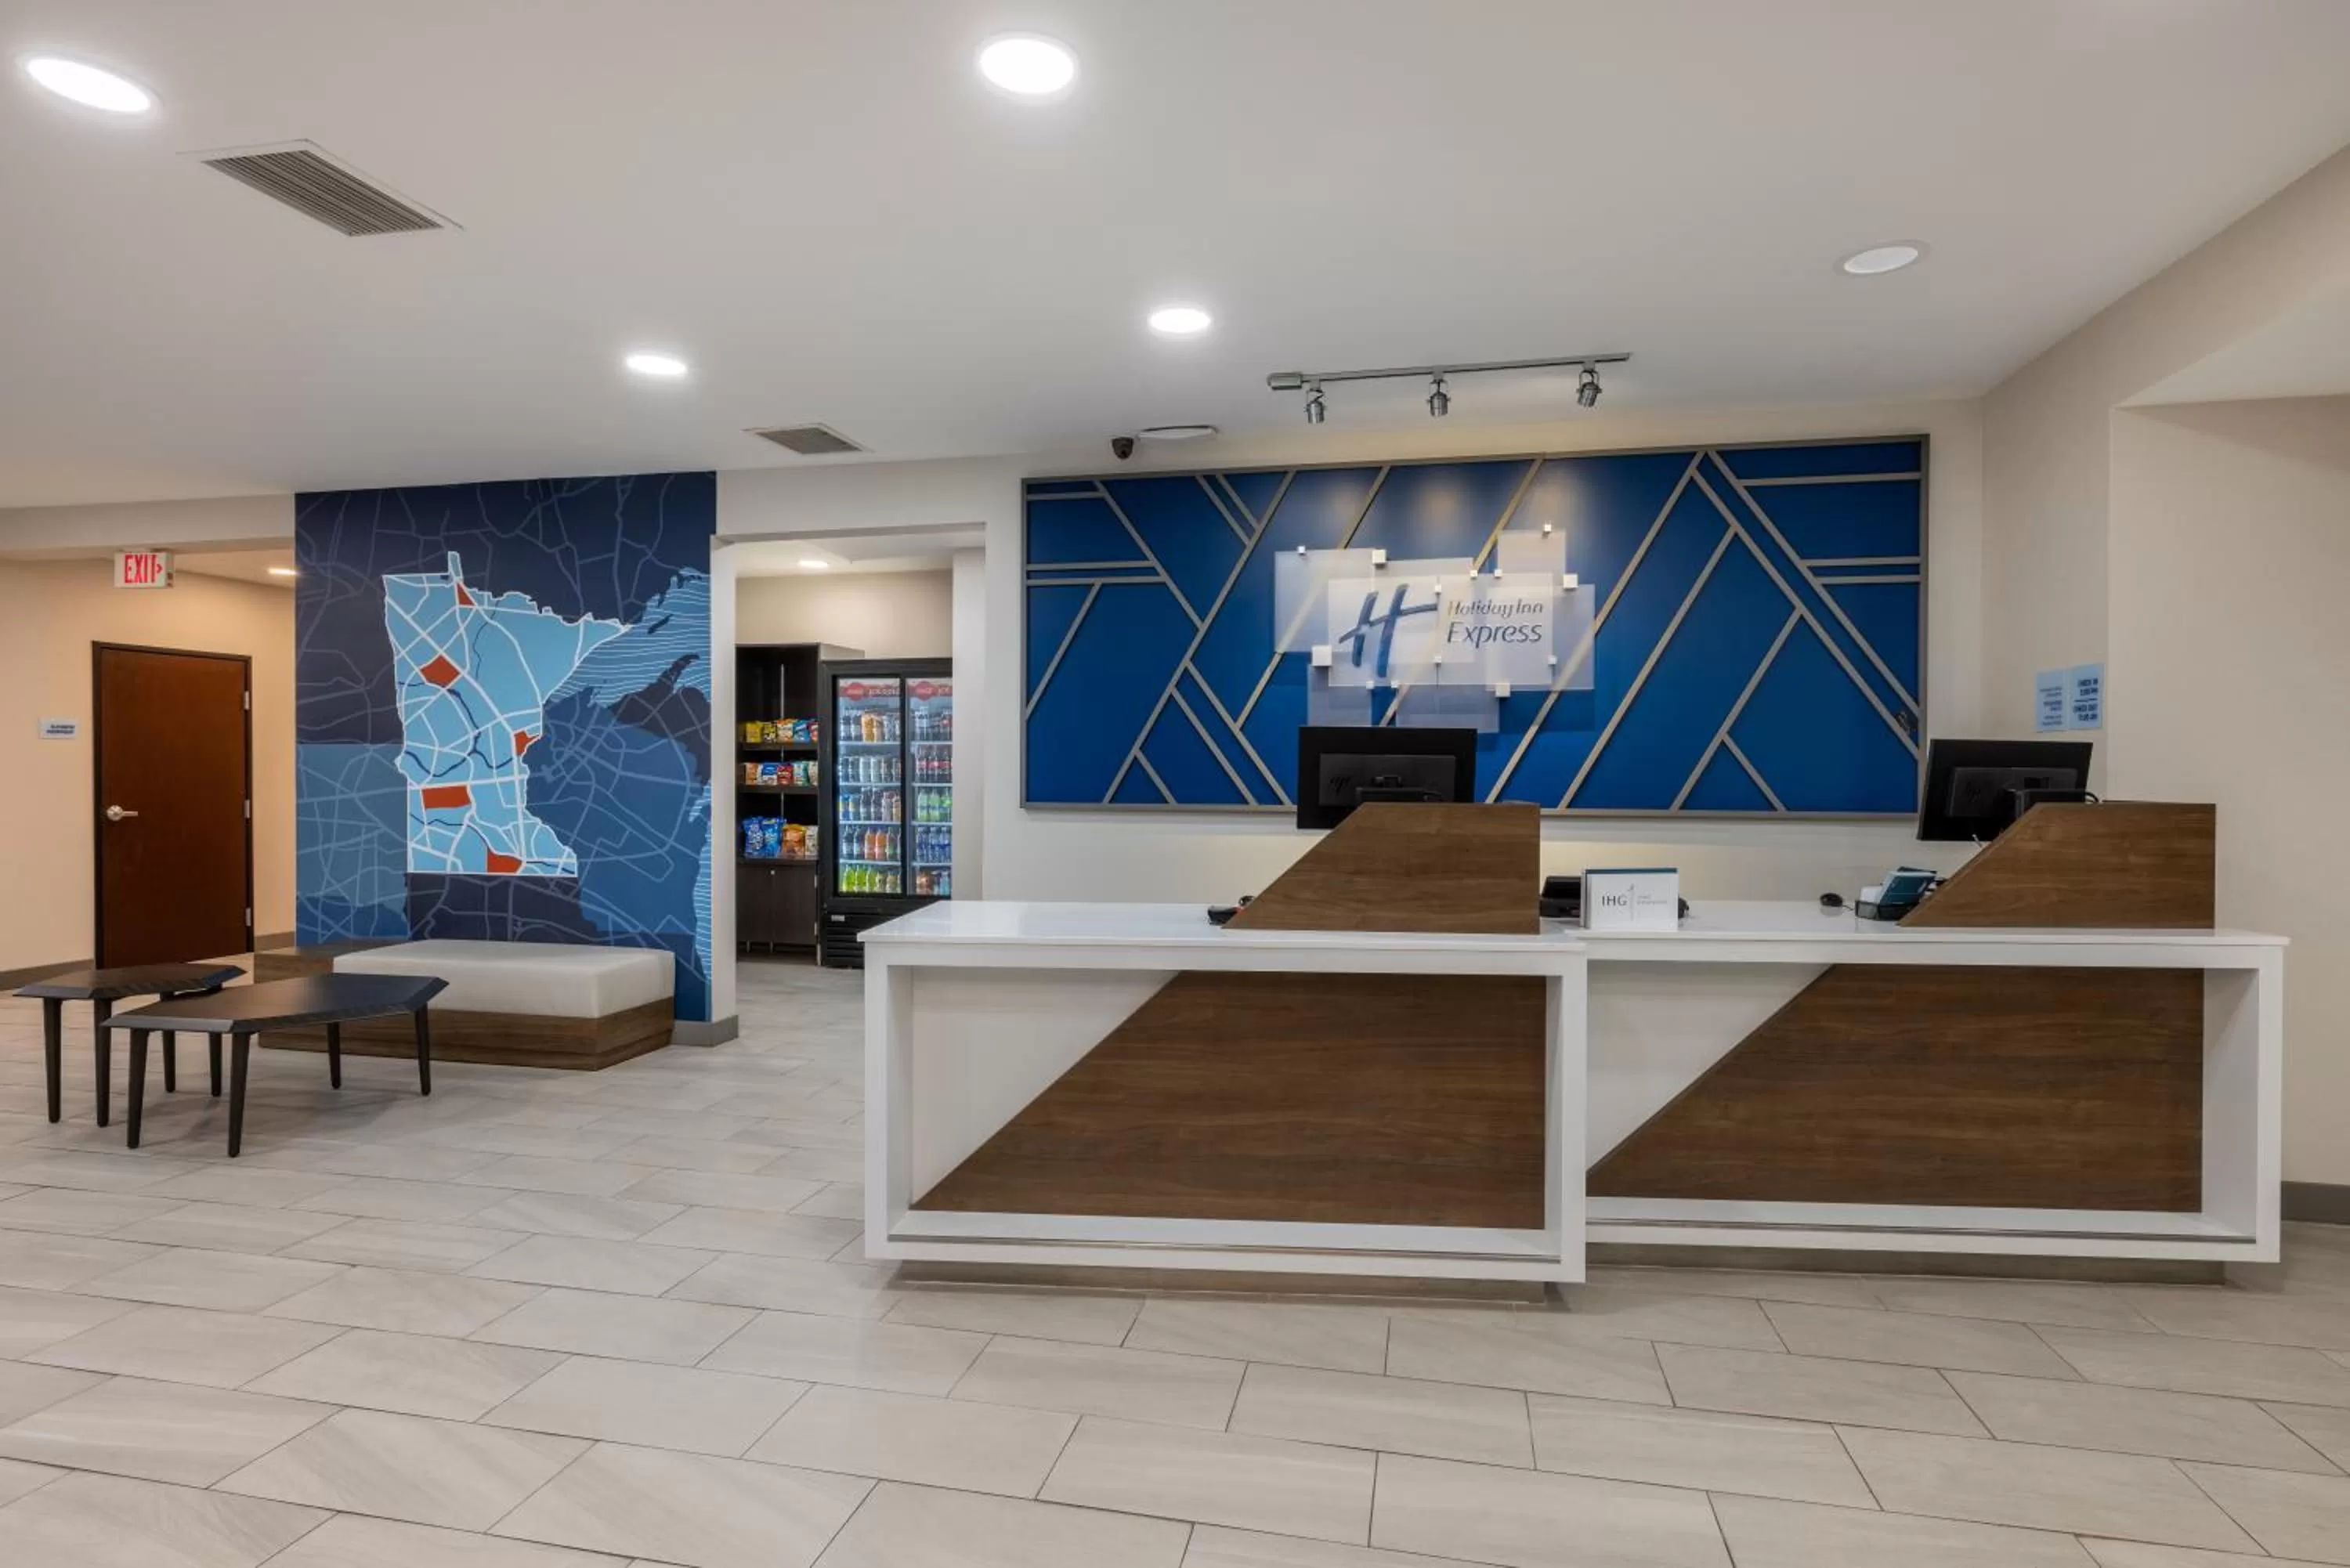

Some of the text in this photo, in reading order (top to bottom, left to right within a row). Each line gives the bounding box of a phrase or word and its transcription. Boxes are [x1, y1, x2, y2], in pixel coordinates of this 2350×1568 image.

[125, 554, 157, 583] EXIT
[1447, 598, 1544, 619] Holiday Inn
[1447, 620, 1543, 649] Express
[1601, 894, 1628, 906] IHG
